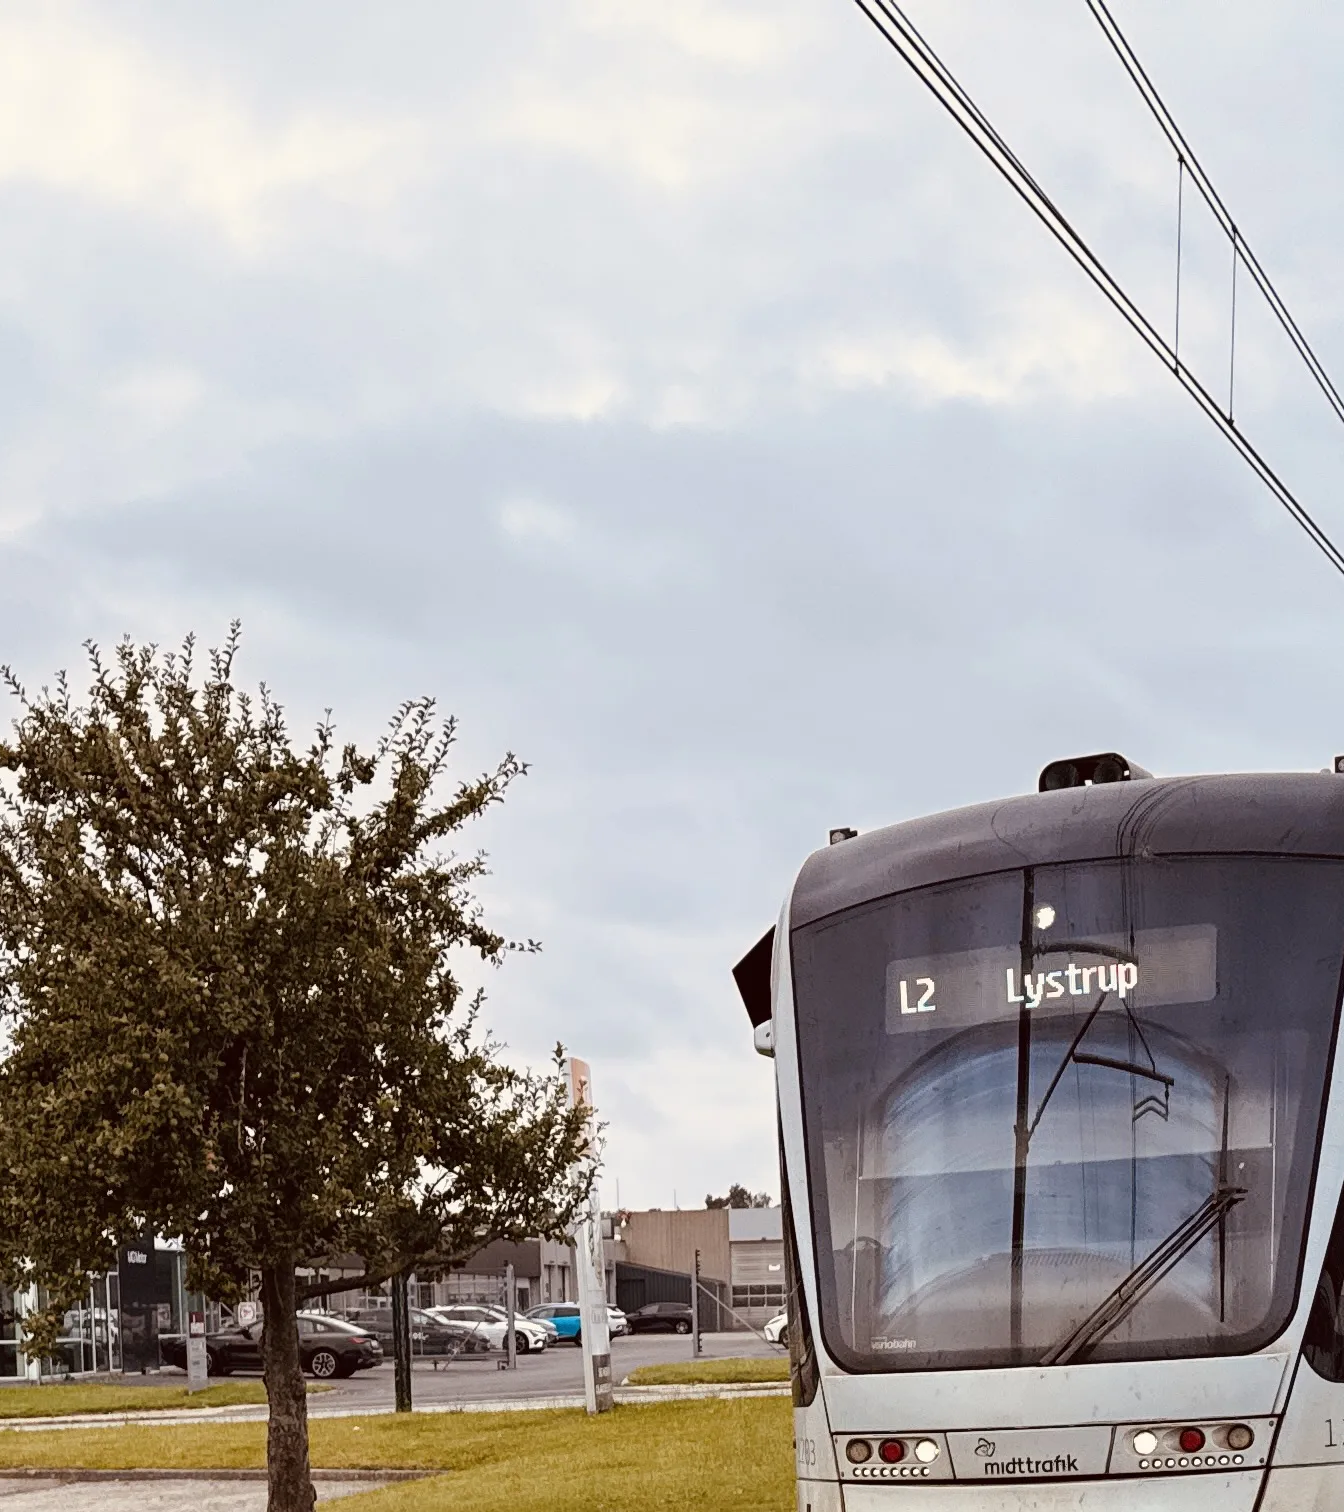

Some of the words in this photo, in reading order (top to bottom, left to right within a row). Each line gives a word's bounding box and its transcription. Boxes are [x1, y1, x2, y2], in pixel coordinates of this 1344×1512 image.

[899, 977, 936, 1015] L2
[1006, 962, 1138, 1009] Lystrup
[984, 1454, 1079, 1475] midttrafik
